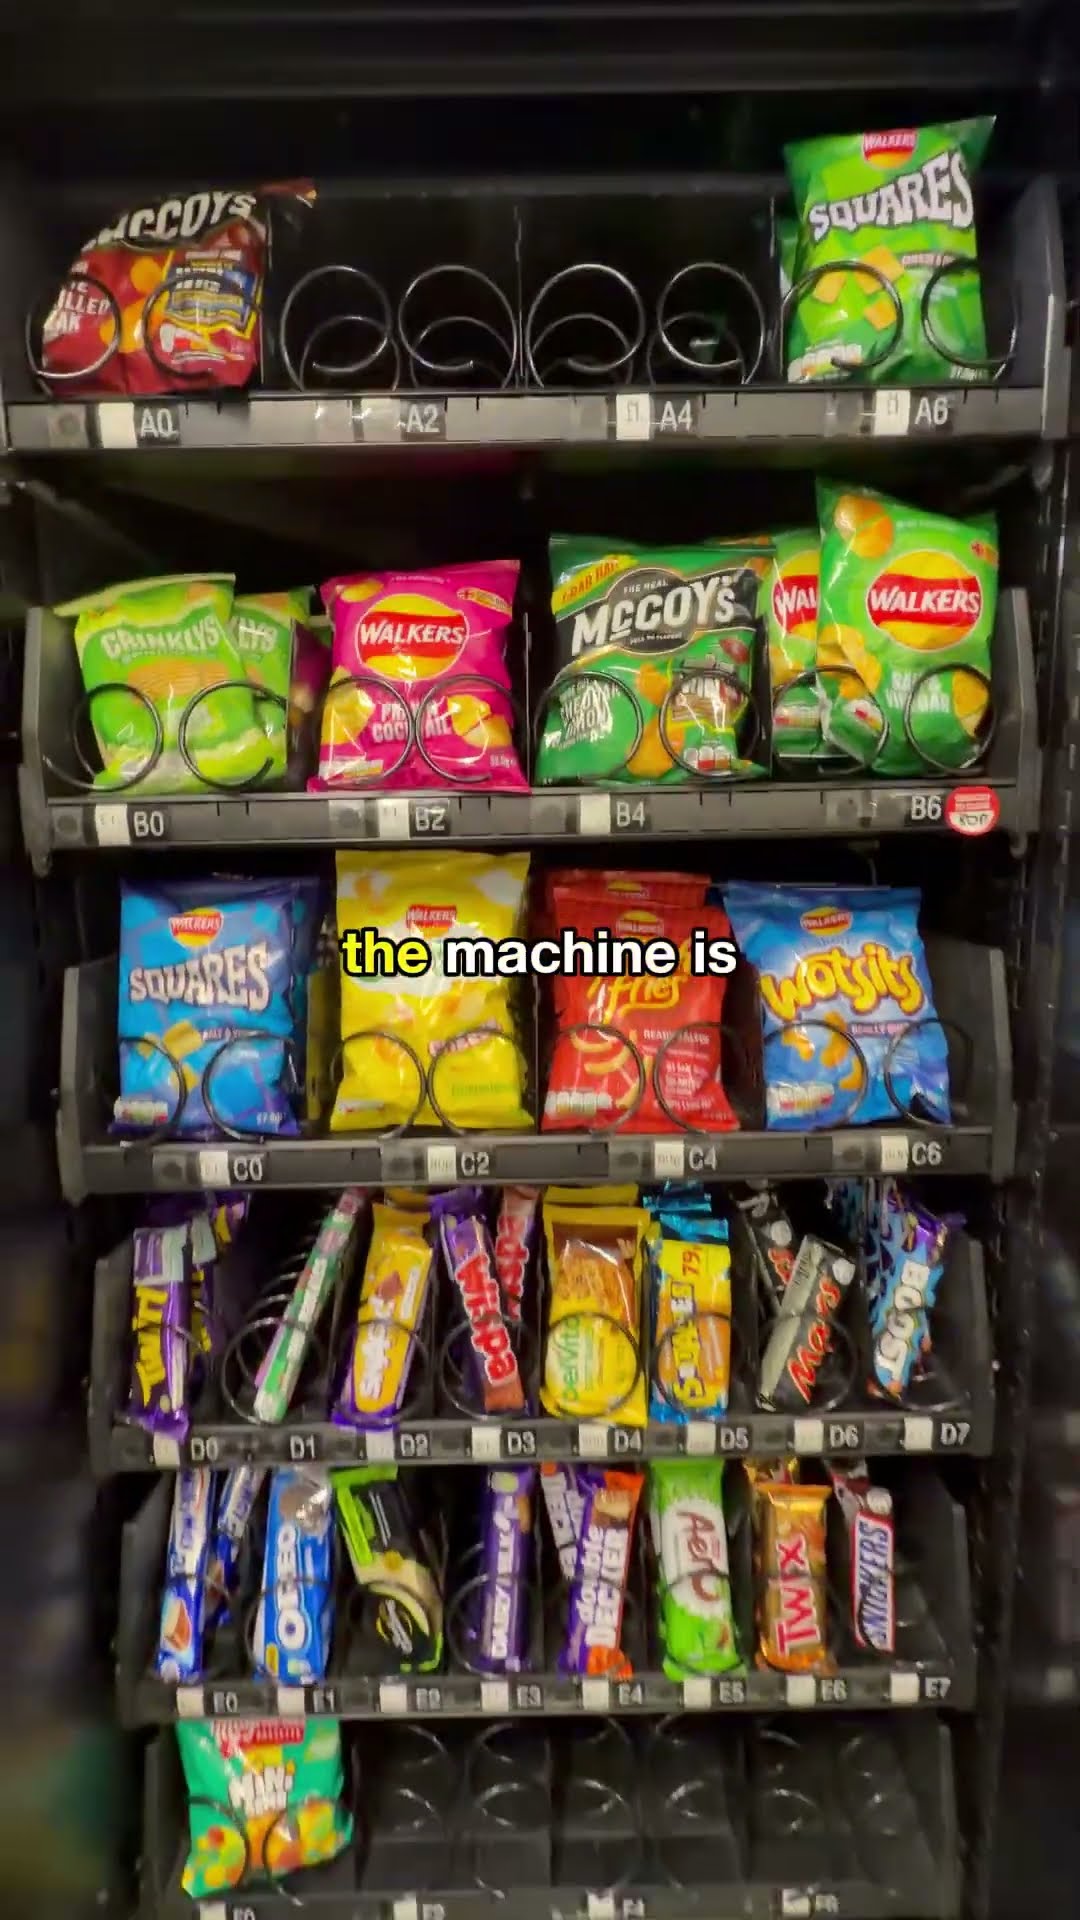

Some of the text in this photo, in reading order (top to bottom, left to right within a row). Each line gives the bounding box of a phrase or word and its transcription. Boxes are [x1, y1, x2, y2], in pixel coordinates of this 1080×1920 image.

[808, 152, 975, 242] SQUARES
[140, 408, 174, 438] A0
[405, 405, 439, 434] A2
[660, 400, 692, 431] A4
[914, 397, 949, 425] A6
[869, 586, 981, 615] WALKERS
[360, 620, 466, 645] WALKERS
[415, 807, 445, 831] B2
[617, 802, 645, 828] B4
[911, 796, 942, 820] B6
[133, 811, 164, 838] B0
[407, 906, 457, 924] WALKERS
[129, 941, 270, 1012] SQUARES
[460, 1152, 490, 1176] C2
[689, 1145, 718, 1171] C4
[912, 1141, 943, 1166] C6
[233, 1157, 264, 1182] C0
[787, 1274, 841, 1405] Mars
[400, 1432, 430, 1456] D2
[507, 1431, 535, 1455] D3
[614, 1428, 641, 1452] D4
[719, 1427, 748, 1450] D5
[829, 1423, 859, 1447] D6
[940, 1421, 970, 1446] D7
[190, 1437, 220, 1461] D0
[290, 1435, 317, 1460] D1
[676, 1510, 721, 1602] Aero
[858, 1520, 890, 1644] SNICKERS
